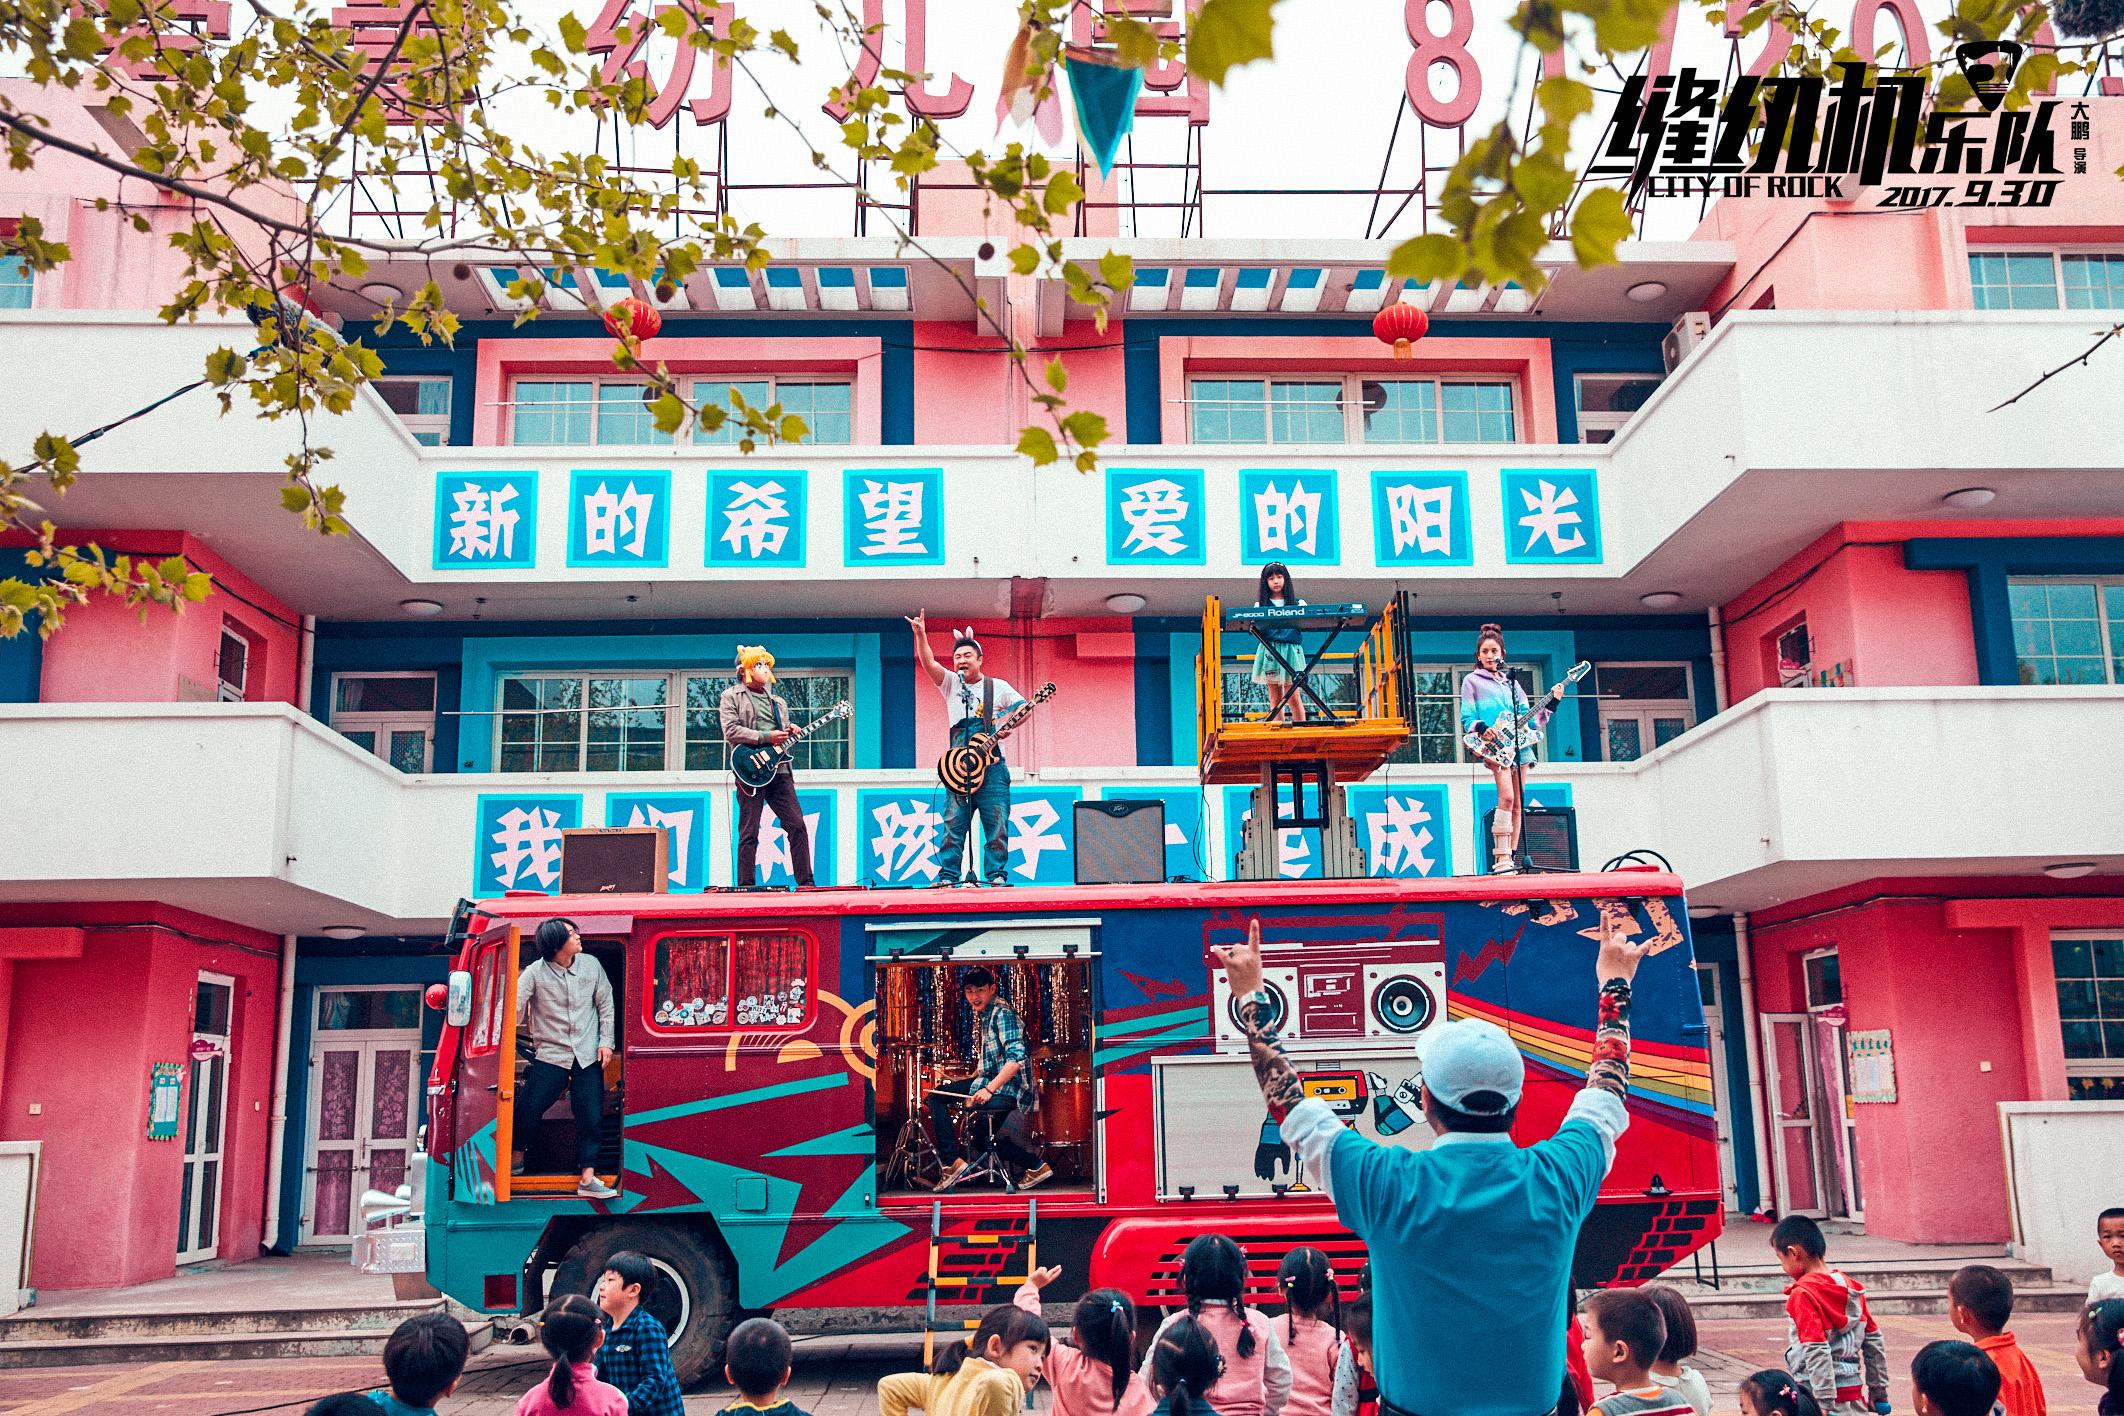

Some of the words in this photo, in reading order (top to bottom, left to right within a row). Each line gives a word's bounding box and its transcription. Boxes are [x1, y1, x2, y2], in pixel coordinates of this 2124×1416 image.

[448, 479, 928, 560] 新的希望
[1120, 478, 1586, 557] 爱的阳光
[1267, 607, 1305, 617] Roland
